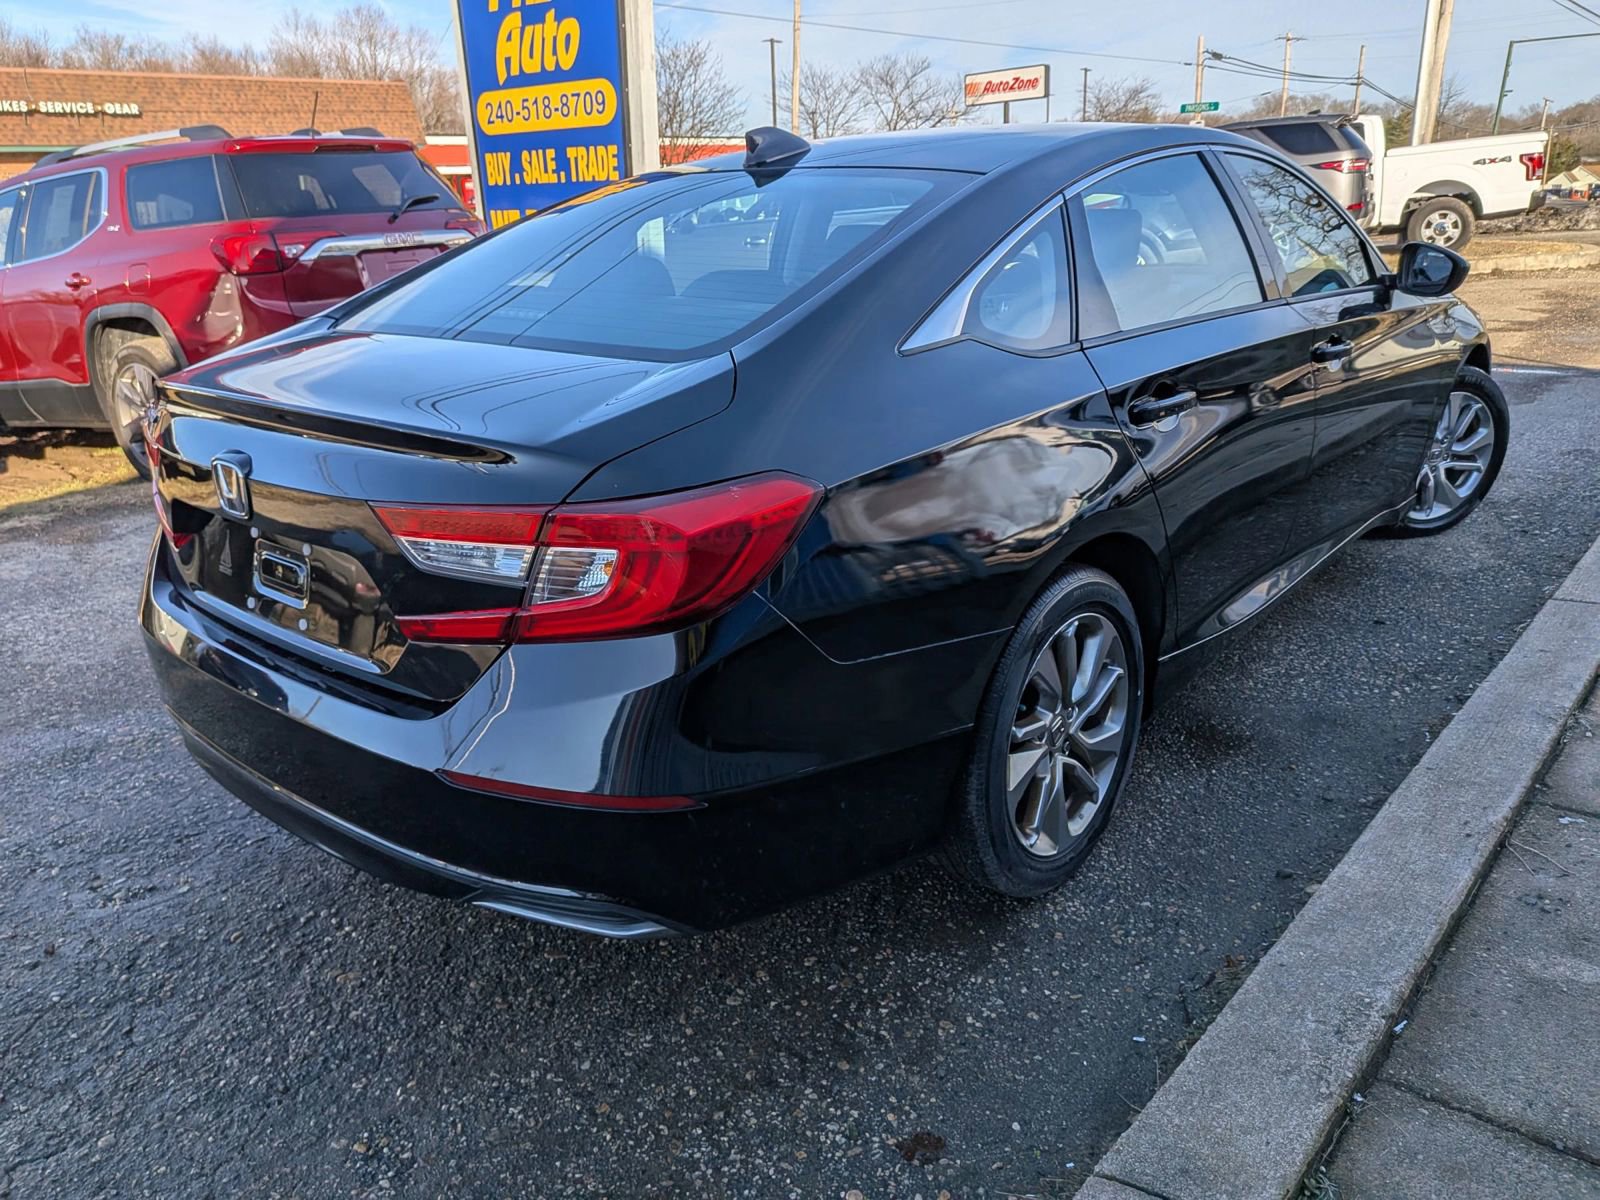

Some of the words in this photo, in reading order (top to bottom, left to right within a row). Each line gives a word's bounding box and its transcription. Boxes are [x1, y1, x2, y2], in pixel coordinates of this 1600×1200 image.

[496, 8, 581, 86] Auto
[982, 76, 1040, 95] AutoZone
[0, 100, 28, 113] KES
[38, 101, 95, 114] SERVICE
[104, 102, 140, 115] GEAR
[485, 89, 606, 126] 240-518-8709
[484, 151, 511, 186] BUY
[521, 148, 558, 185] SALE
[566, 144, 620, 183] TRADE
